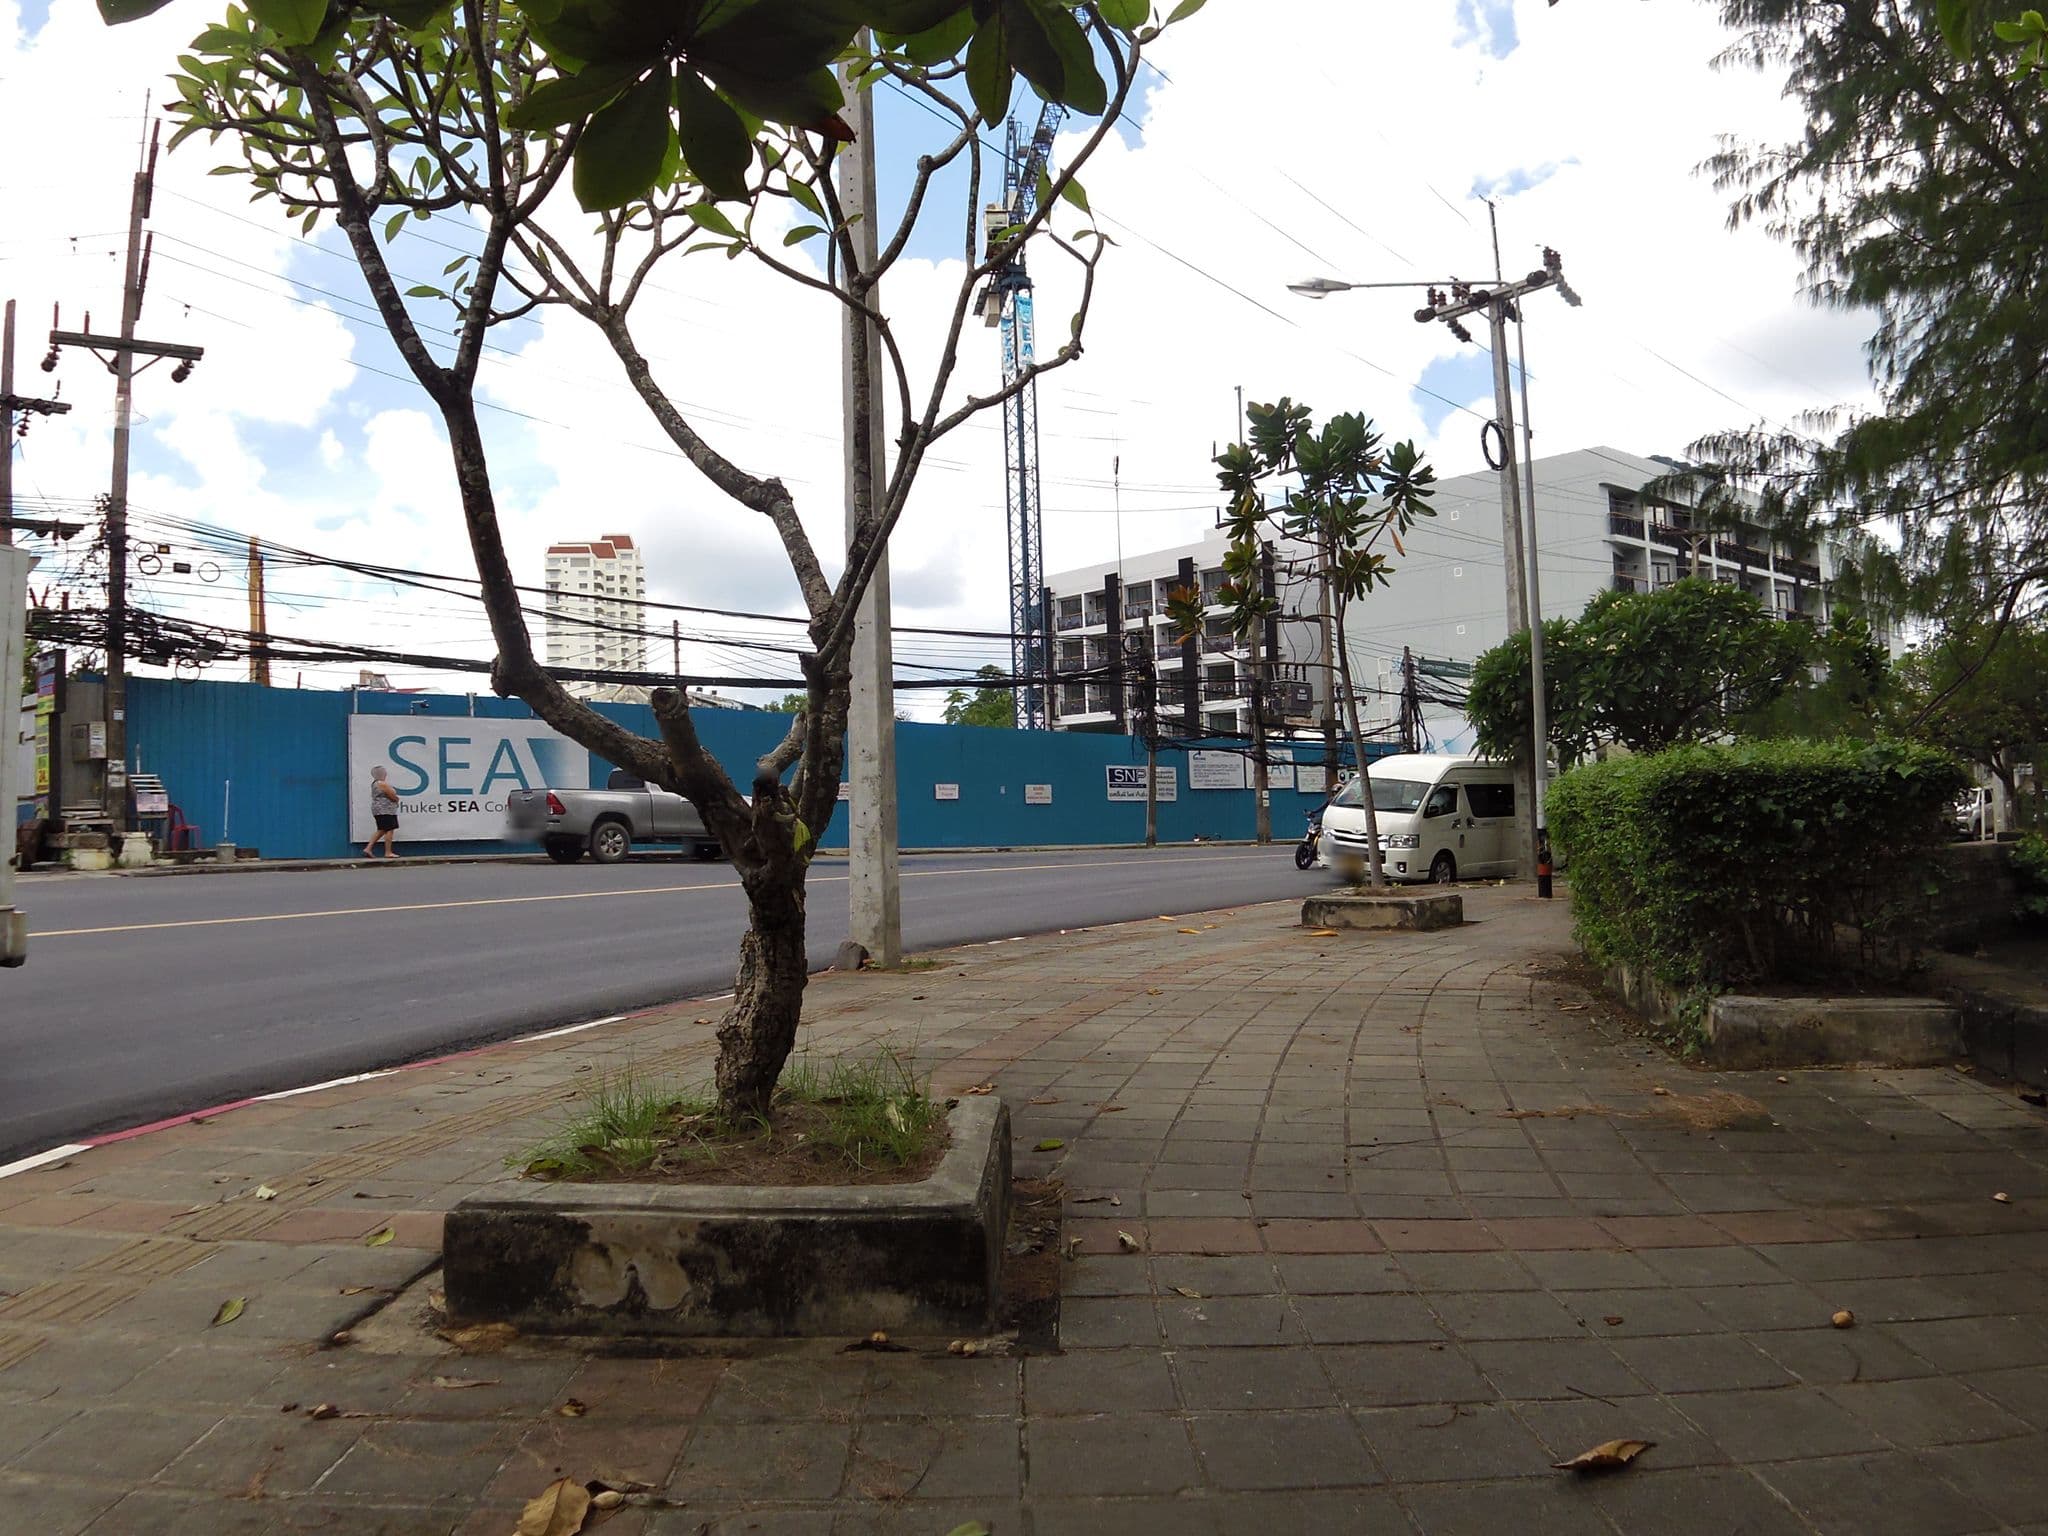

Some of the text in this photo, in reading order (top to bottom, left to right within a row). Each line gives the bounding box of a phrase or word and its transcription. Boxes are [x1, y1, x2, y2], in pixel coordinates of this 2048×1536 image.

[388, 735, 531, 796] SEA
[399, 802, 443, 814] huket
[448, 801, 480, 813] SEA
